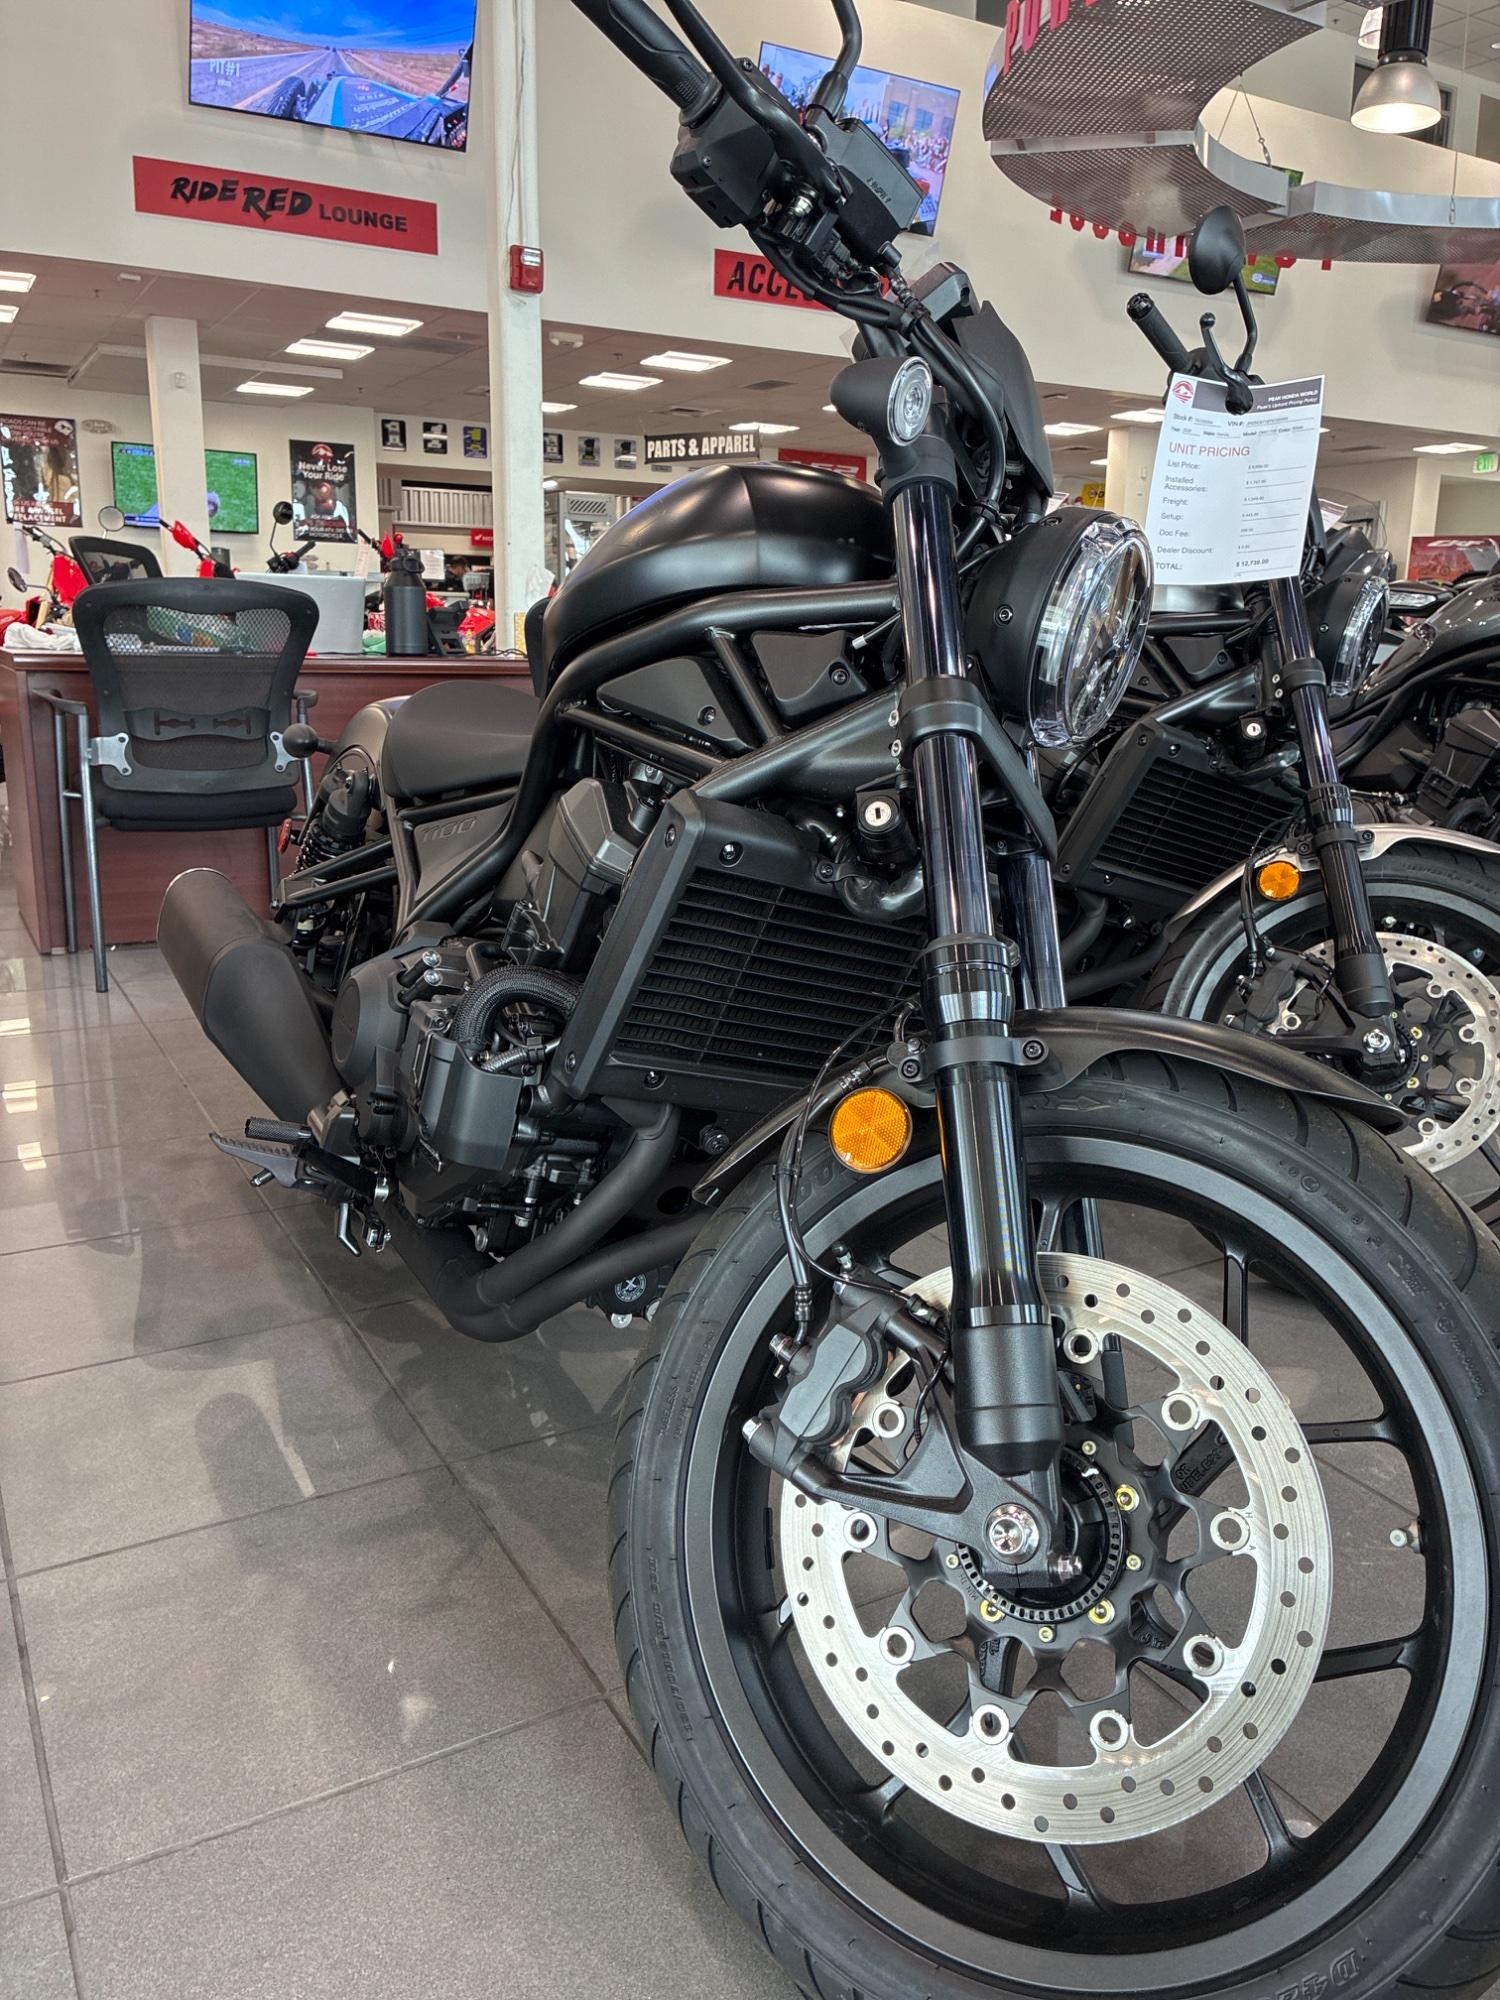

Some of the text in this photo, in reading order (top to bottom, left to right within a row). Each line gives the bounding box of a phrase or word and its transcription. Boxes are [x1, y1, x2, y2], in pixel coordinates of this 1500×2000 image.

[170, 176, 408, 232] RIDE RED LOUNGE
[647, 434, 755, 458] PARTS & APPAREL
[1169, 442, 1250, 457] UNIT PRICING
[298, 460, 348, 473] Never Lose
[1167, 459, 1201, 470] List Price:
[302, 470, 345, 481] Your Ride
[1165, 475, 1194, 484] Installed
[1162, 497, 1189, 506] Freight:
[1160, 512, 1184, 521] Setup:
[1159, 528, 1173, 536] Doc
[1157, 545, 1180, 554] Dealer
[1155, 561, 1183, 570] TOTAL:
